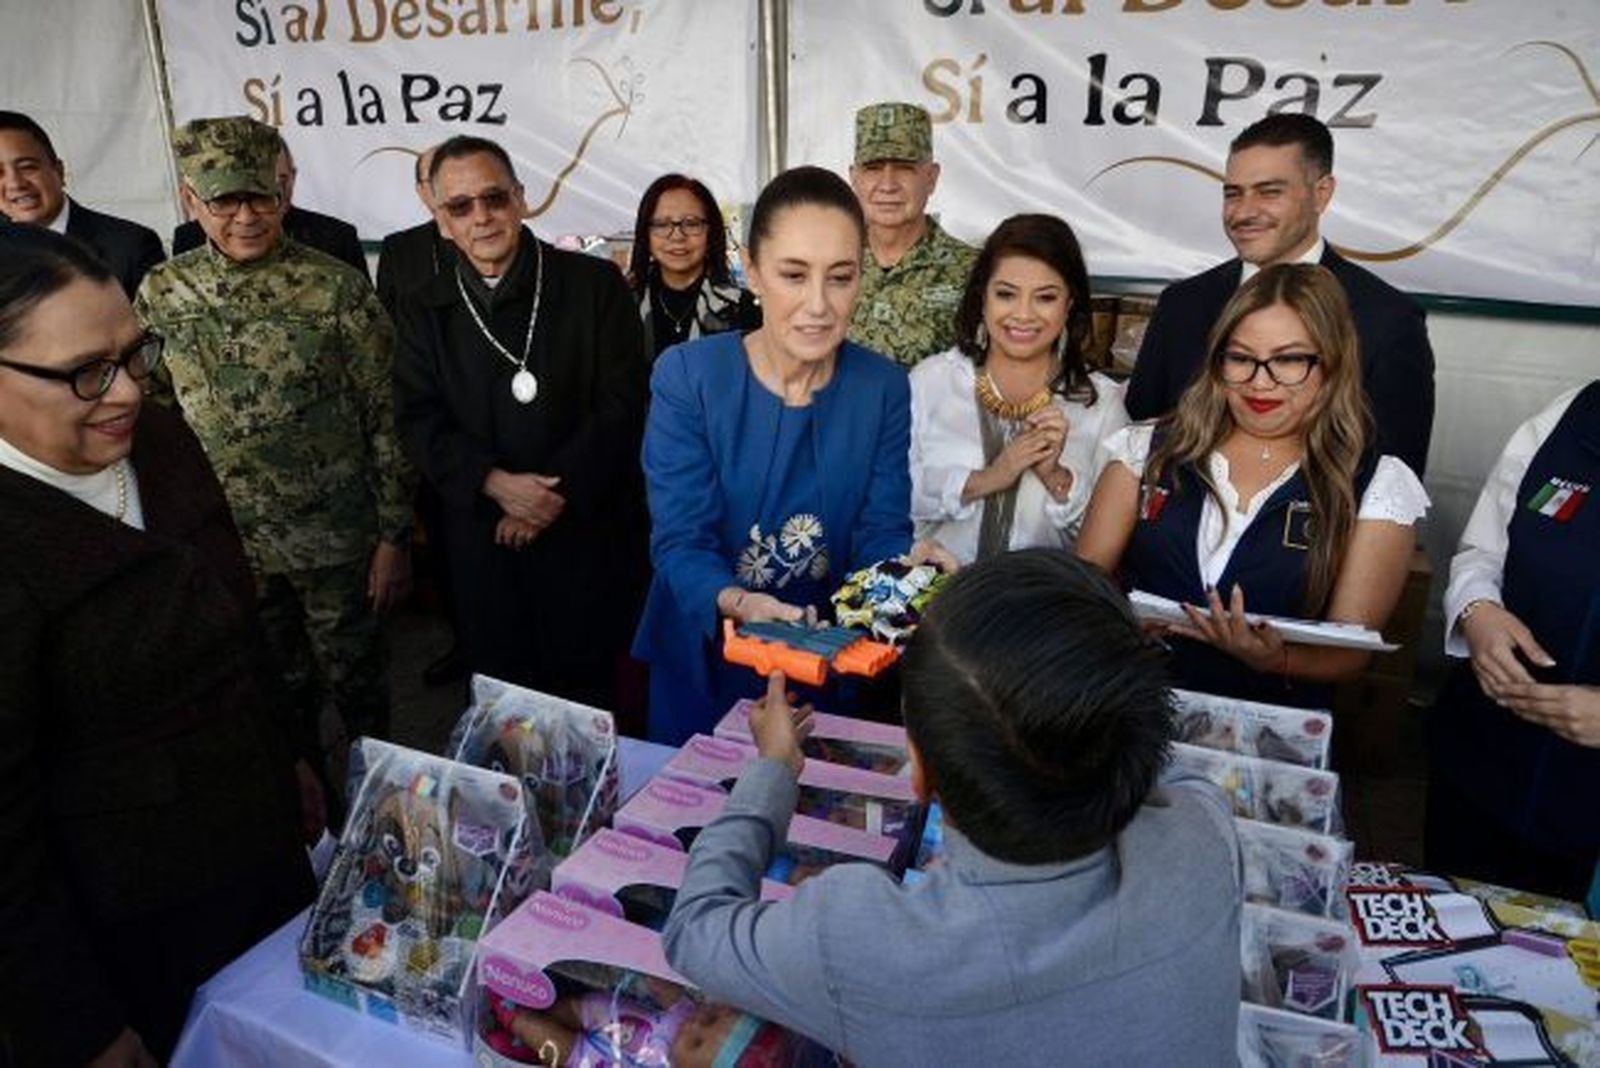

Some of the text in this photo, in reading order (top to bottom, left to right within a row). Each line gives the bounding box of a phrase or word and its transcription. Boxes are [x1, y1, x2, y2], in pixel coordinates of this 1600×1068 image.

[281, 0, 328, 43] al
[244, 70, 507, 126] Sí a la Paz
[923, 53, 1383, 128] Sí a la Paz
[1349, 893, 1427, 920] TECH
[1365, 918, 1445, 941] DECK
[1366, 991, 1455, 1022] TECH
[1385, 1020, 1474, 1048] DECK
